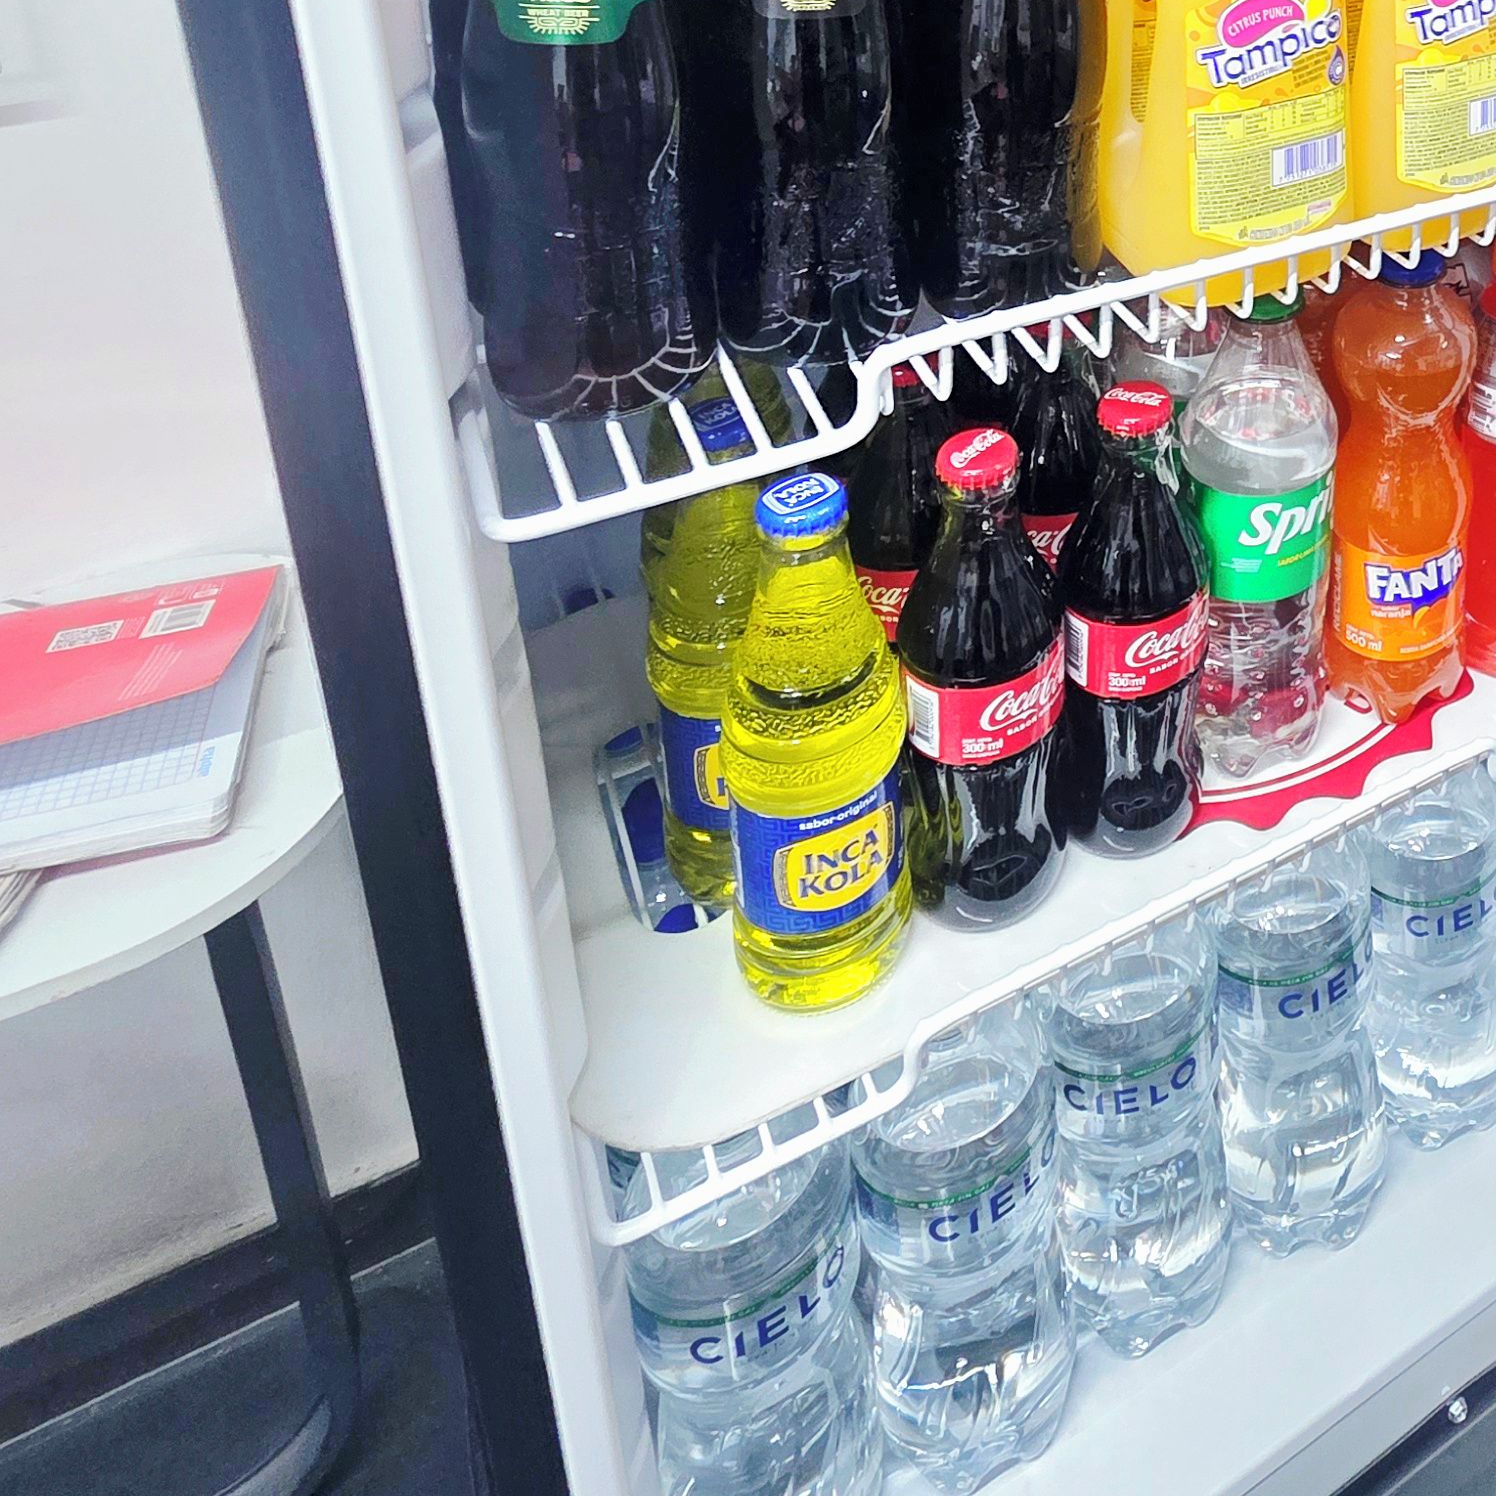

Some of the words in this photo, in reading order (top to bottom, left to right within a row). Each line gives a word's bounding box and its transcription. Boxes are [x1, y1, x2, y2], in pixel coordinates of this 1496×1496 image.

[526, 7, 564, 19] WHEAT
[564, 7, 590, 19] BEER
[1227, 13, 1262, 38] CITRUS
[1262, 5, 1294, 23] PUNCH
[1200, 13, 1342, 84] Tampico
[1103, 387, 1169, 407] Coca-Cola
[949, 428, 1006, 469] Coca-Cola
[1108, 676, 1129, 687] 300
[1129, 675, 1146, 687] ml
[1149, 658, 1180, 675] SABOR
[1006, 714, 1039, 737] SABOR
[961, 742, 986, 754] 300
[987, 737, 1004, 752] ml
[803, 829, 880, 876] INCA
[799, 849, 884, 900] KOLA
[1063, 1056, 1197, 1115] CIELO
[689, 1245, 845, 1364] CIELO
